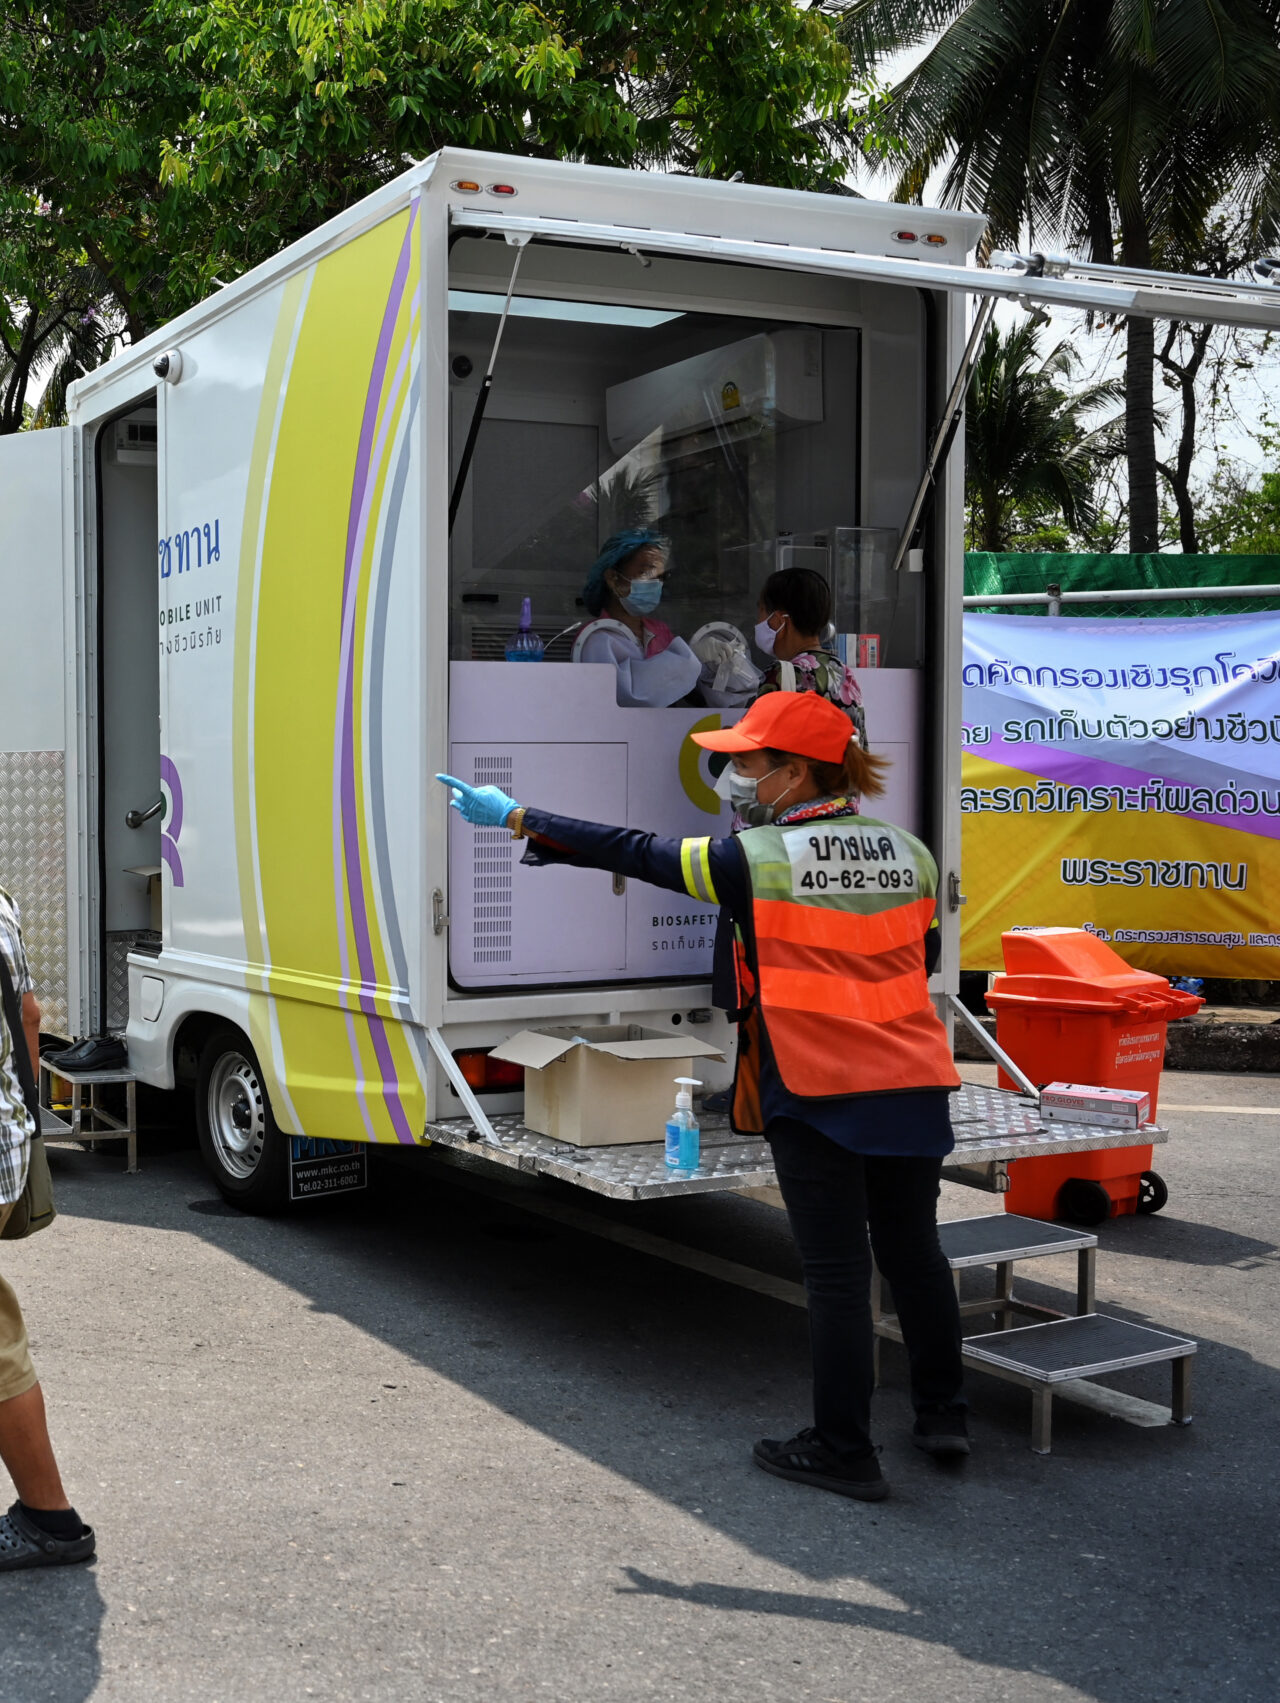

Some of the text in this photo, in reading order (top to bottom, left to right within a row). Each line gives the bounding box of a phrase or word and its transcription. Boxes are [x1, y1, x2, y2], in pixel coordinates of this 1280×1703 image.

[160, 595, 222, 626] OBILE UNIT
[962, 652, 1280, 694] ดคัดกรองเชิงรุกโควิ
[809, 836, 896, 861] บางแค
[801, 869, 913, 889] 40-62-093
[1062, 859, 1246, 889] พระราชทาน
[296, 1161, 360, 1179] www.mkc.co.th
